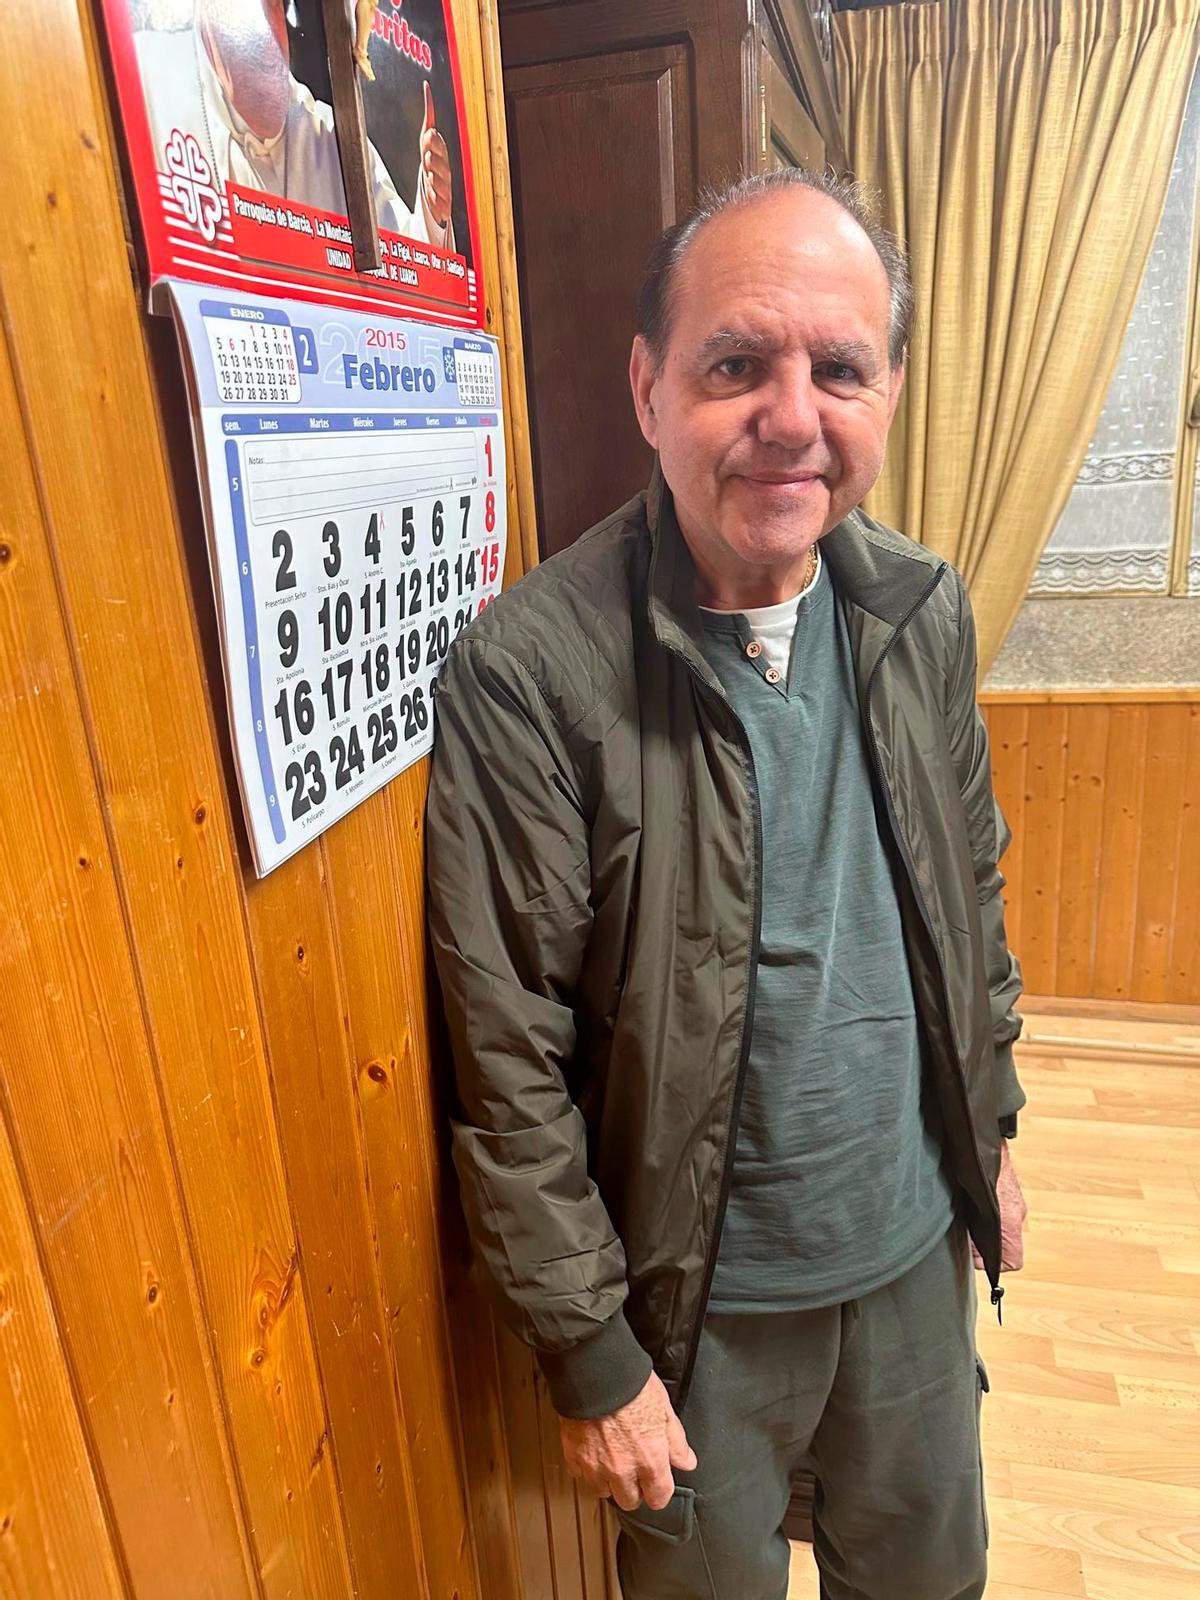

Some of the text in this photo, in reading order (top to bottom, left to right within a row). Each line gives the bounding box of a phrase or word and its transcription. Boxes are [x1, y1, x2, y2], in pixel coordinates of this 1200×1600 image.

[370, 7, 432, 71] aritas
[233, 193, 276, 225] Parroquias
[276, 206, 288, 228] de
[287, 209, 314, 238] Barcia,
[314, 217, 325, 237] La
[326, 247, 352, 270] UNIDAD
[230, 307, 264, 320] ENERO
[250, 325, 288, 340] 1 2 3 4
[365, 328, 406, 350] 2015
[216, 337, 292, 356] 5 6 7 8 9 10 11
[299, 334, 312, 366] 2
[464, 342, 481, 351] MARZO
[218, 354, 294, 370] 12 13 14 15 16 17 18
[221, 371, 296, 386] 19 20 21 22 23 24 25
[342, 353, 436, 393] Febrero
[223, 387, 288, 400] 26 27 28 29 30 31
[224, 421, 241, 431] sem.
[259, 418, 278, 430] Lunes
[309, 418, 330, 428] Martes
[484, 434, 492, 477] 1
[232, 478, 239, 491] 5
[272, 491, 495, 592] 2 3 4 5 6 7 8
[242, 561, 248, 576] 6
[278, 609, 299, 668] 9
[318, 591, 352, 652] 10
[360, 578, 386, 635] 11
[396, 568, 422, 620] 12
[427, 558, 449, 607] 13
[455, 550, 476, 596] 14
[481, 543, 499, 586] 15
[250, 645, 256, 659] 7
[274, 680, 315, 746] 16
[321, 658, 353, 721] 17
[361, 643, 390, 700] 18
[396, 629, 420, 681] 19
[426, 616, 449, 666] 20
[256, 720, 262, 732] 8
[285, 687, 428, 822] 23 24 25 26
[270, 794, 275, 806] 9
